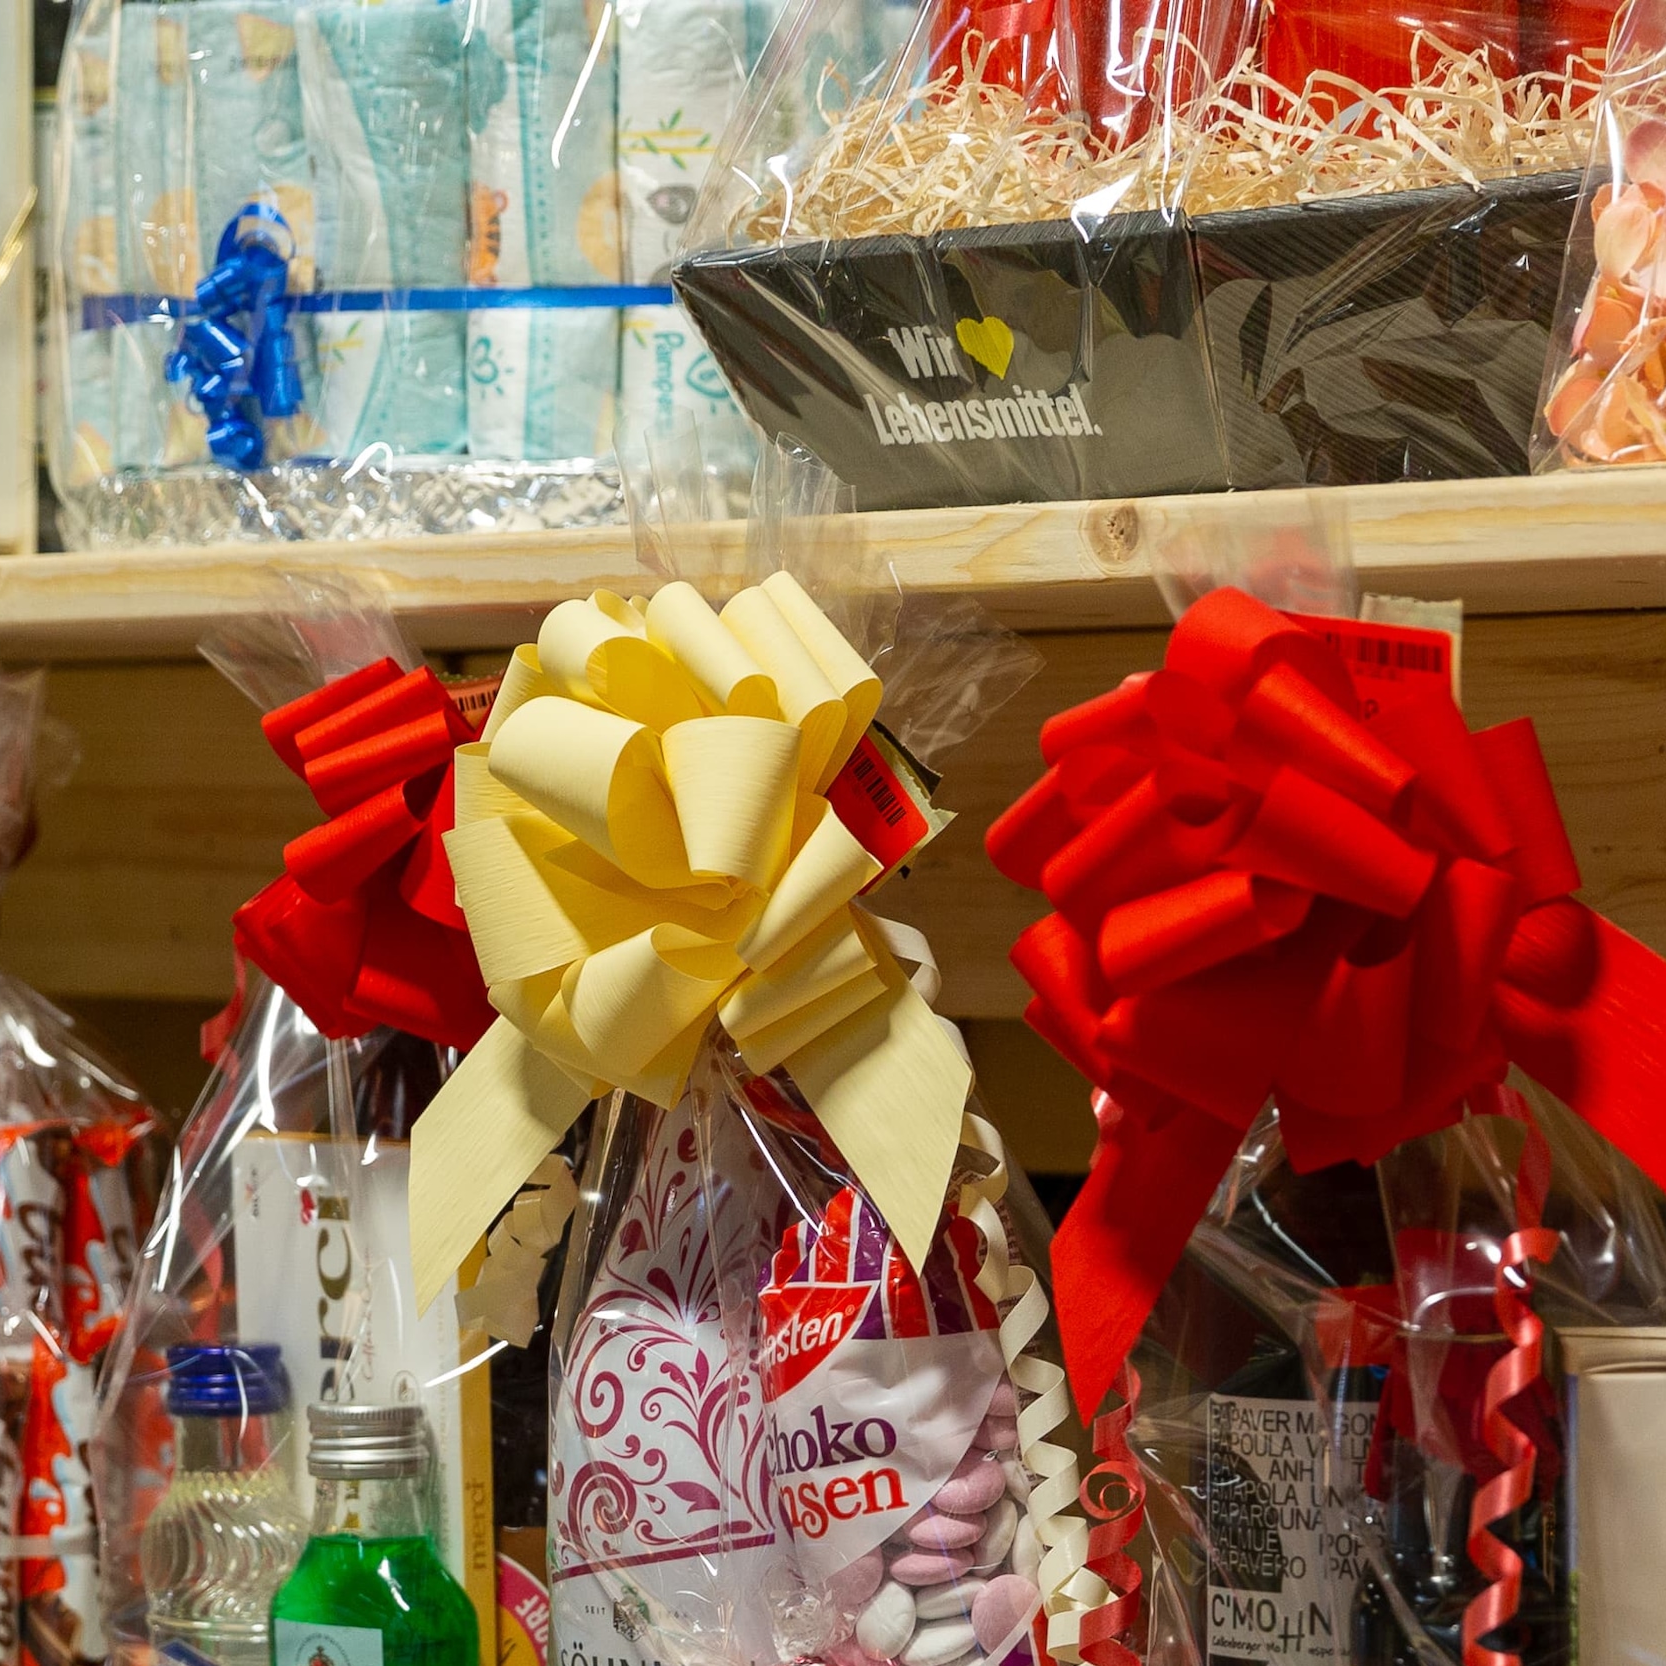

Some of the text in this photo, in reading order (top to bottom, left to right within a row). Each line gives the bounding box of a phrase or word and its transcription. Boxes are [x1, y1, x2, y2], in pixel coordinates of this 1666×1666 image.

[888, 325, 958, 379] Wir
[864, 383, 1103, 446] Lebensmittel.
[584, 1604, 606, 1616] SEIT
